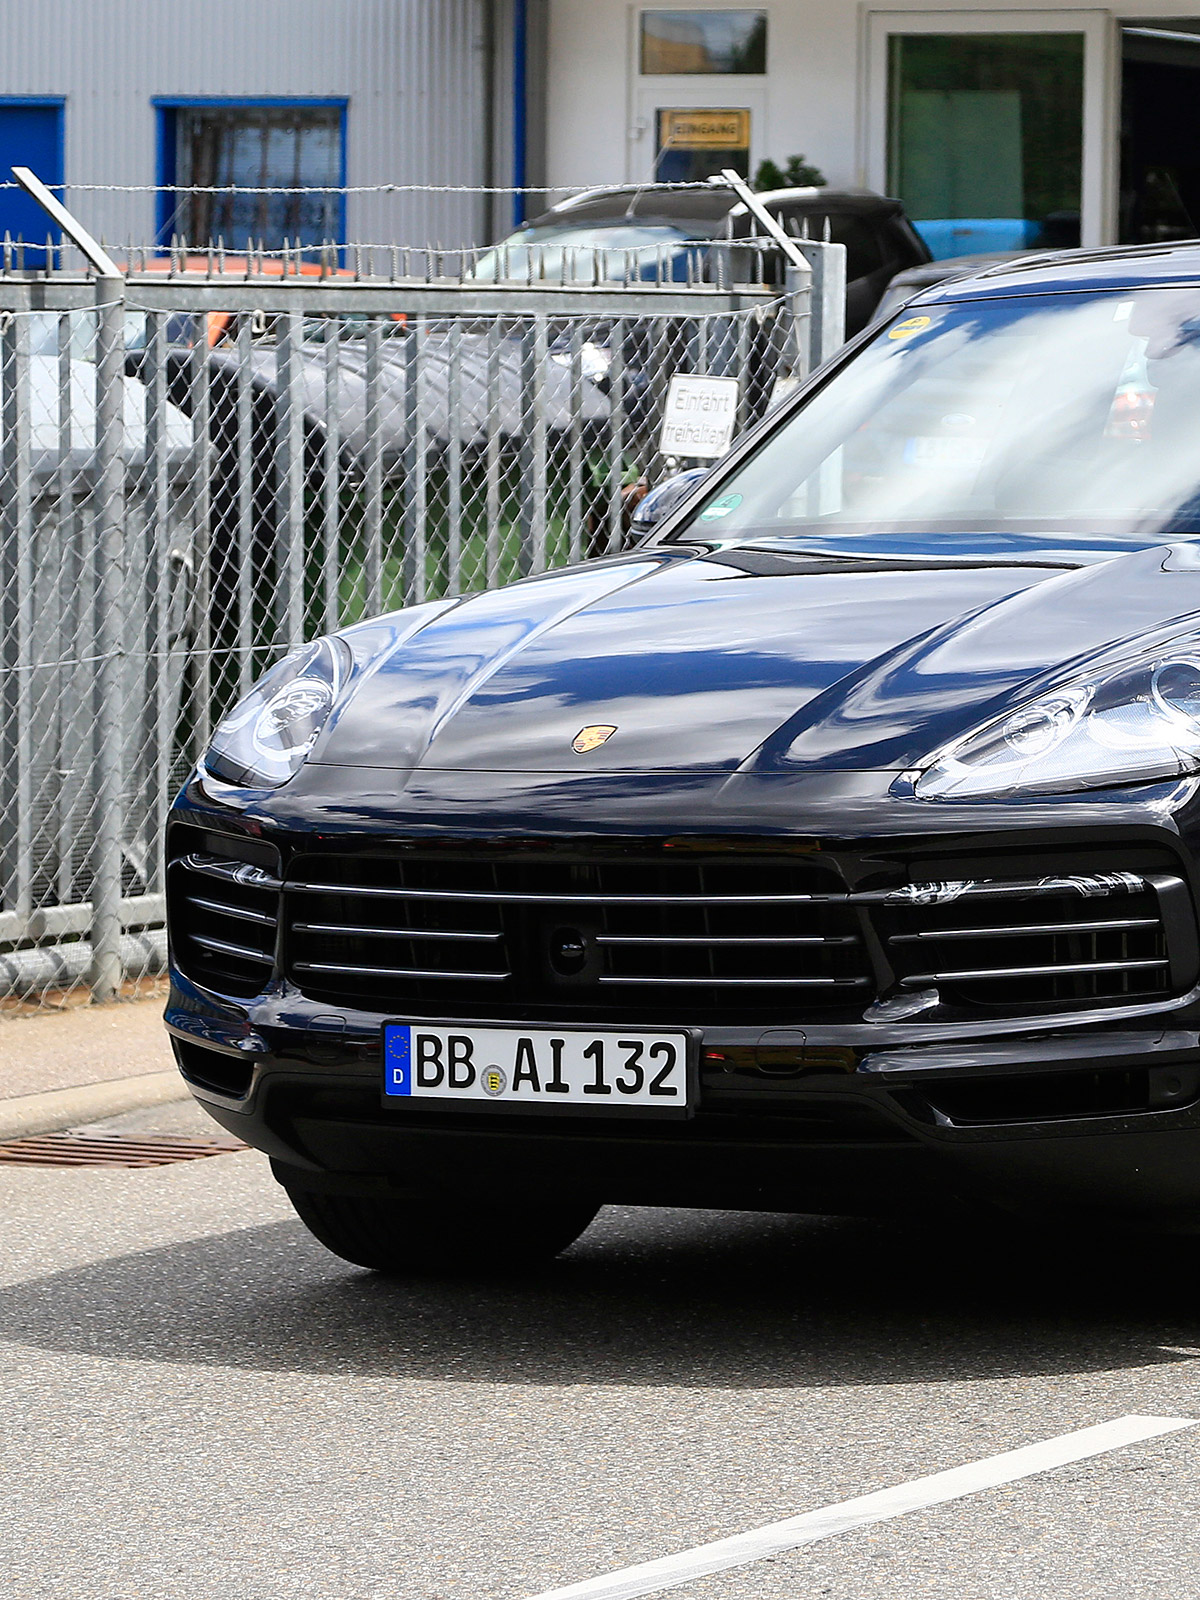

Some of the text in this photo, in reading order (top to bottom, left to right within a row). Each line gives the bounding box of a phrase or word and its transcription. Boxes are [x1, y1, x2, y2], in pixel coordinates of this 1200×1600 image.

[675, 386, 731, 413] Einfahrt
[416, 1033, 477, 1089] BB
[392, 1068, 404, 1084] D
